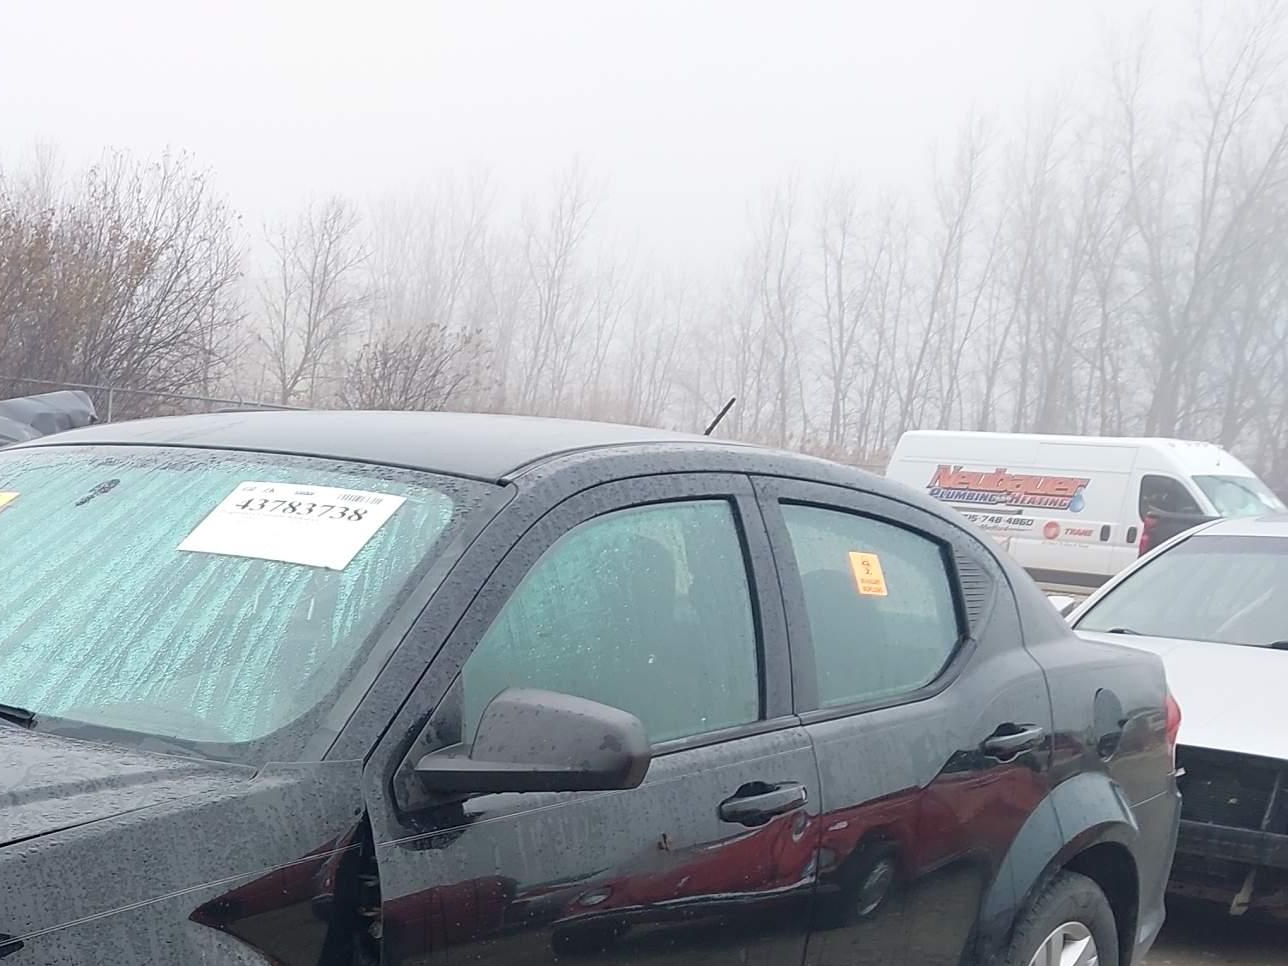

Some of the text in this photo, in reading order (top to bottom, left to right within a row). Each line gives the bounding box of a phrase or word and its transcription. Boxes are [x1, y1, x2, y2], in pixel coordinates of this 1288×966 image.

[927, 464, 1091, 496] Neubauer
[235, 498, 368, 522] 43783738
[1006, 493, 1073, 509] HEATING
